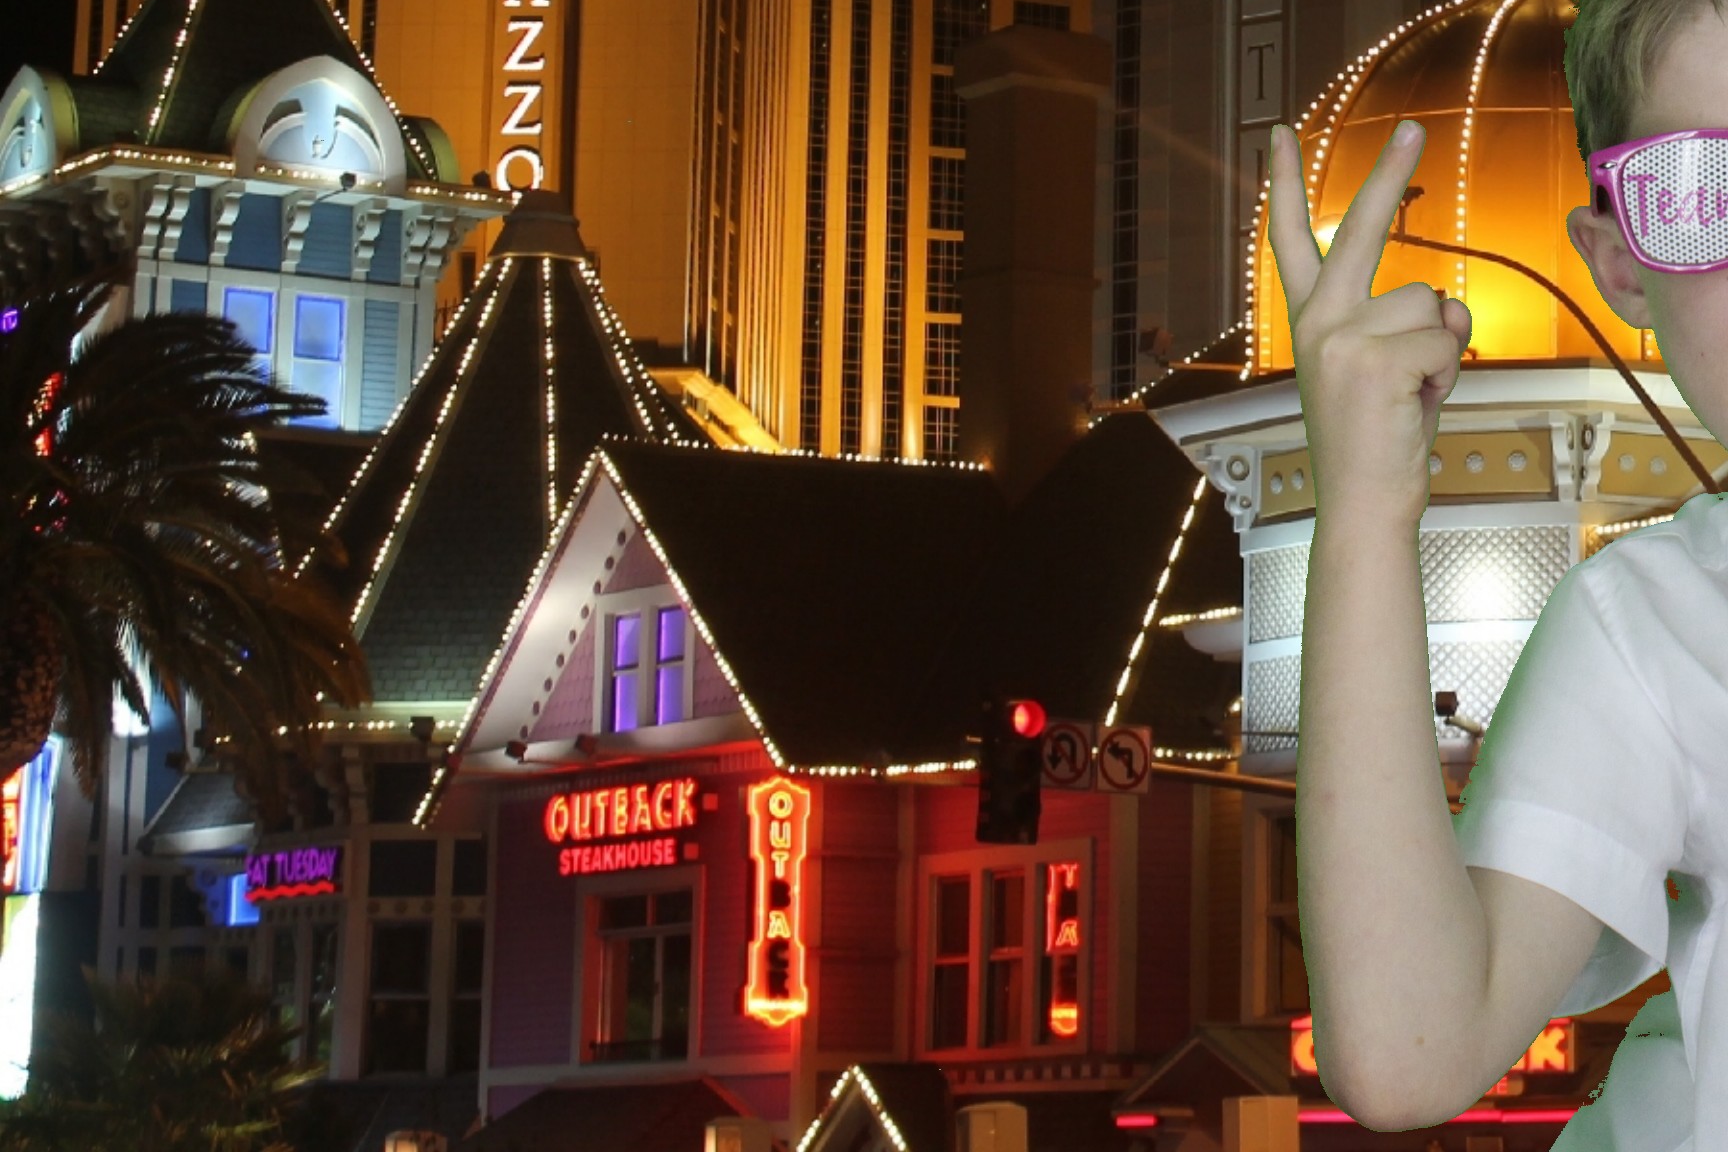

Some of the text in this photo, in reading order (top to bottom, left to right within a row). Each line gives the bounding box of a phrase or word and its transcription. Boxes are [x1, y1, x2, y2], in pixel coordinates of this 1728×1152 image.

[545, 778, 696, 842] OUTBACK
[275, 846, 337, 884] TUESDAY
[559, 837, 676, 875] STEAKHOUSE
